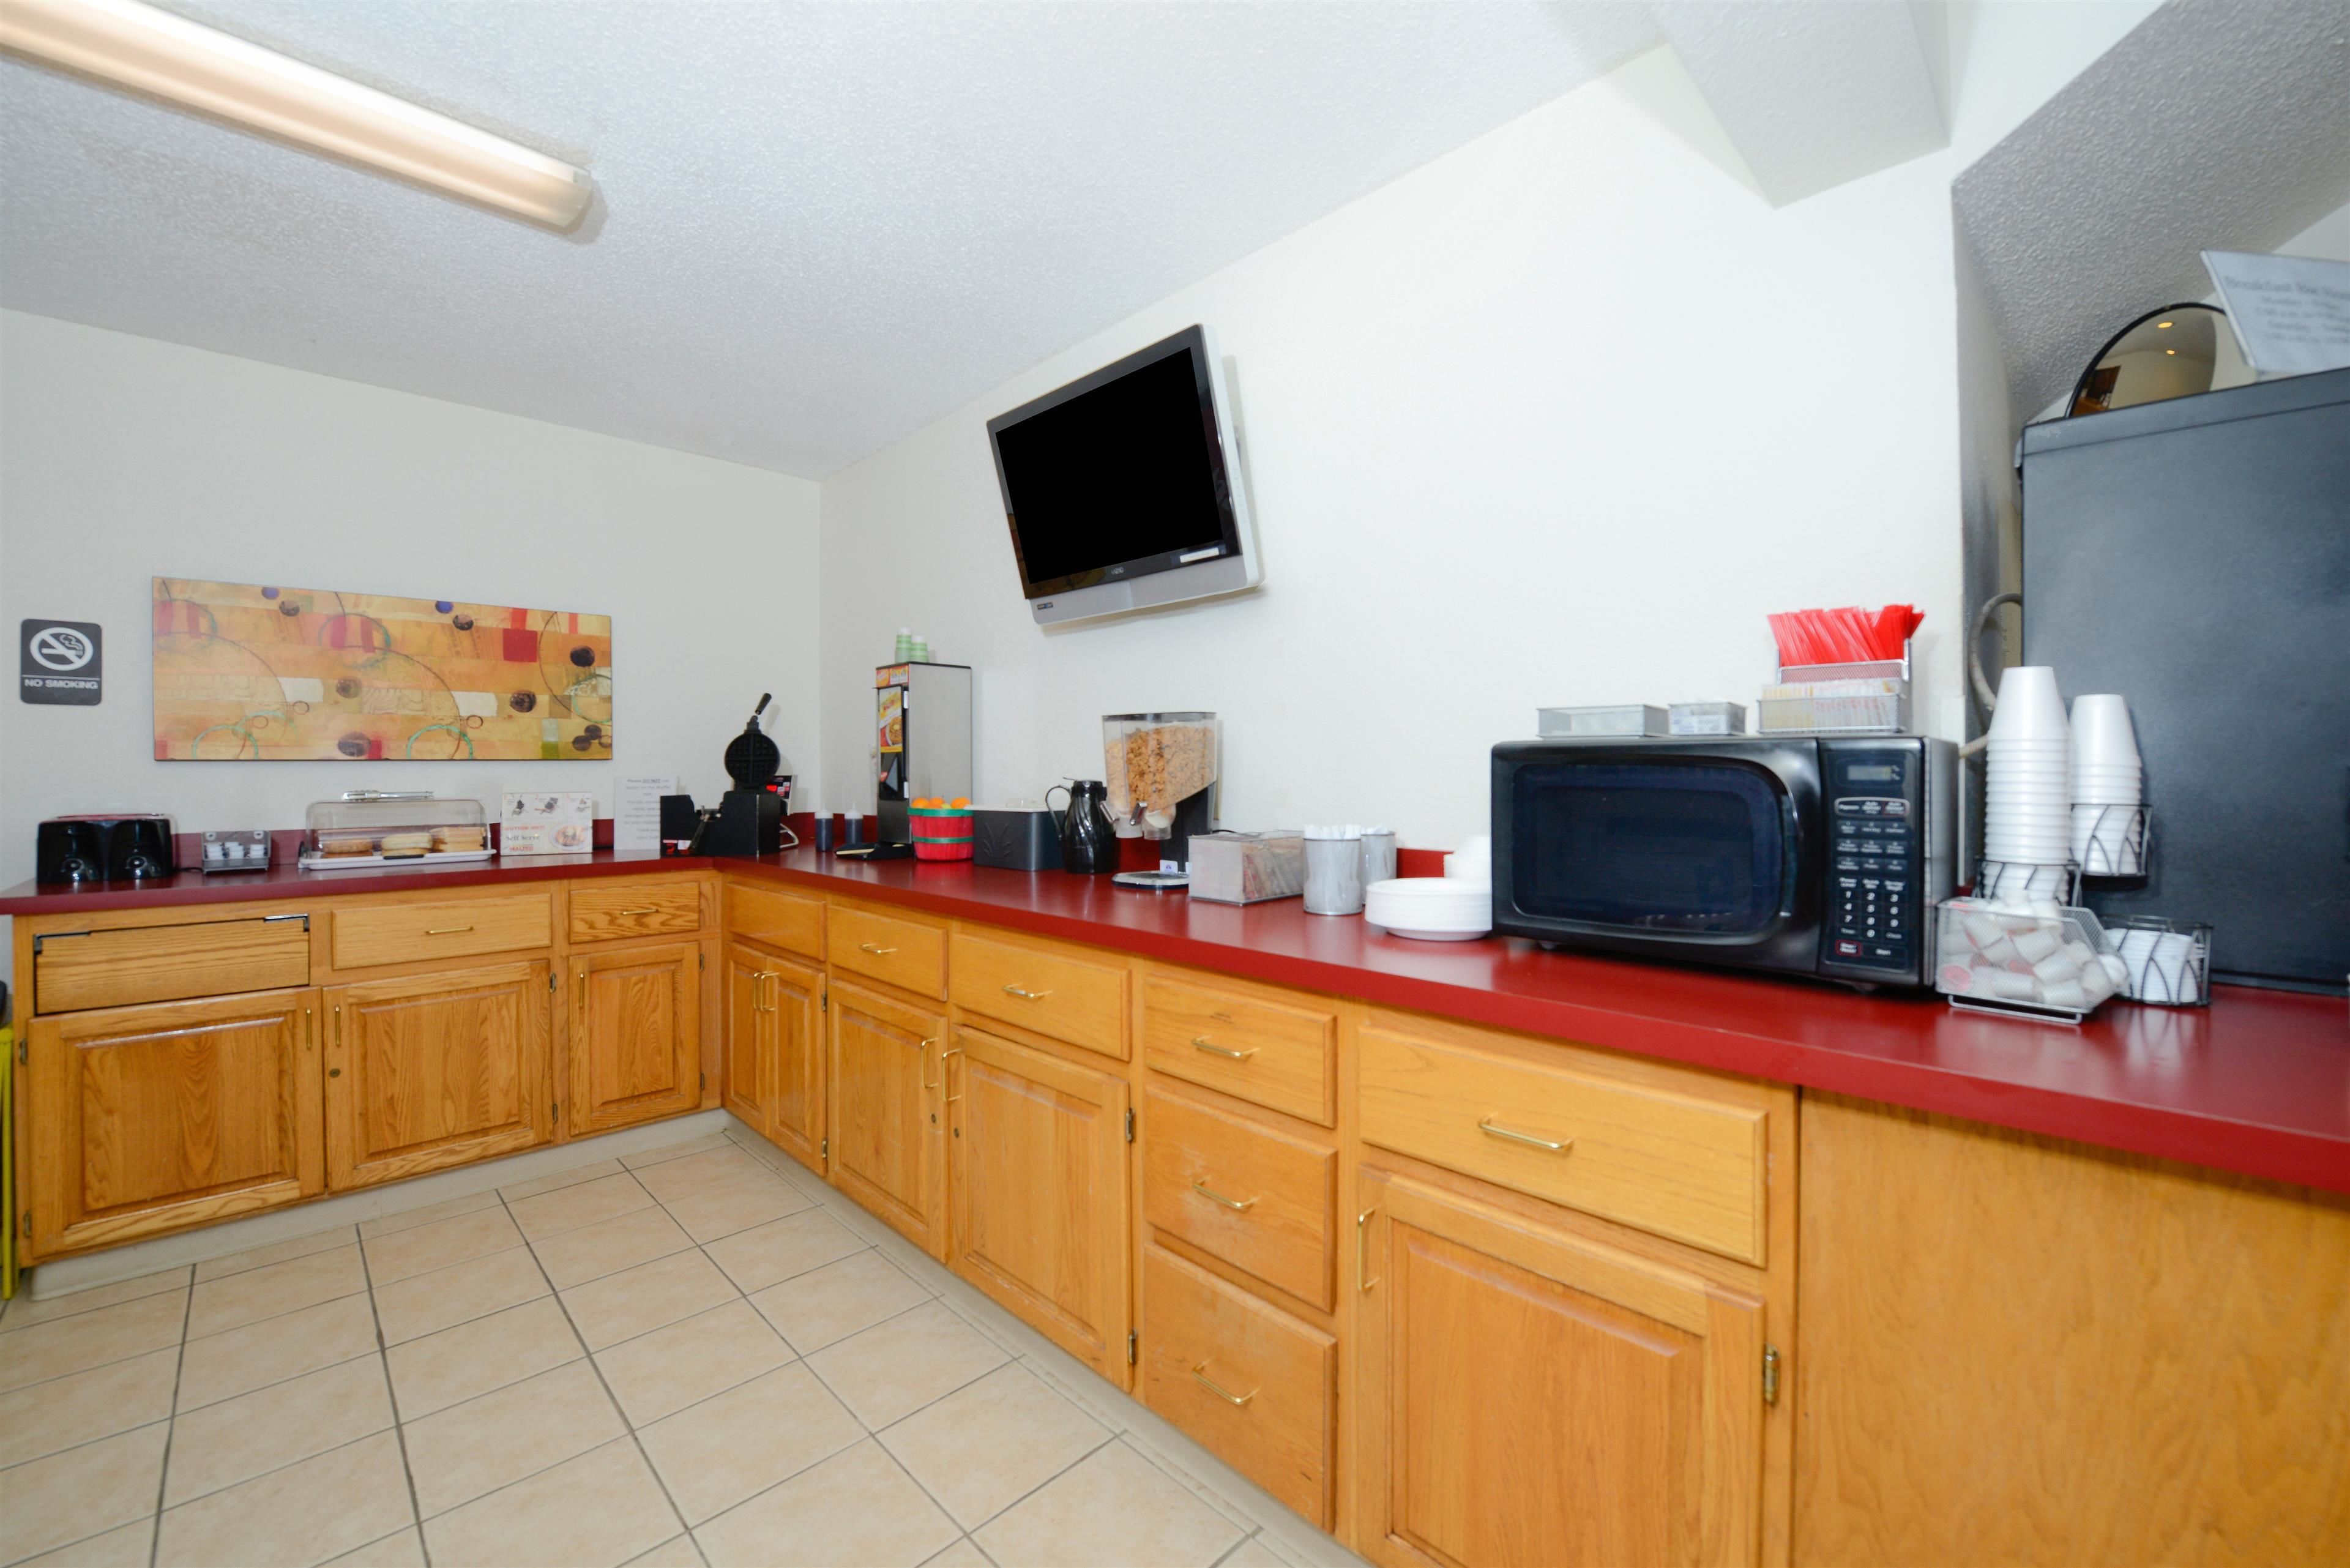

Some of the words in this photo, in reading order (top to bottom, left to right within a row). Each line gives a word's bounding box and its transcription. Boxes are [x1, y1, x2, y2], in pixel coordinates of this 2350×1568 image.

[24, 679, 43, 687] NO
[45, 680, 99, 689] SMOKING
[1867, 892, 1875, 901] 2
[1890, 894, 1898, 902] 3
[1890, 906, 1899, 915] 6
[1867, 917, 1875, 925] 8
[1890, 919, 1898, 927] 9
[1867, 929, 1875, 938] 0
